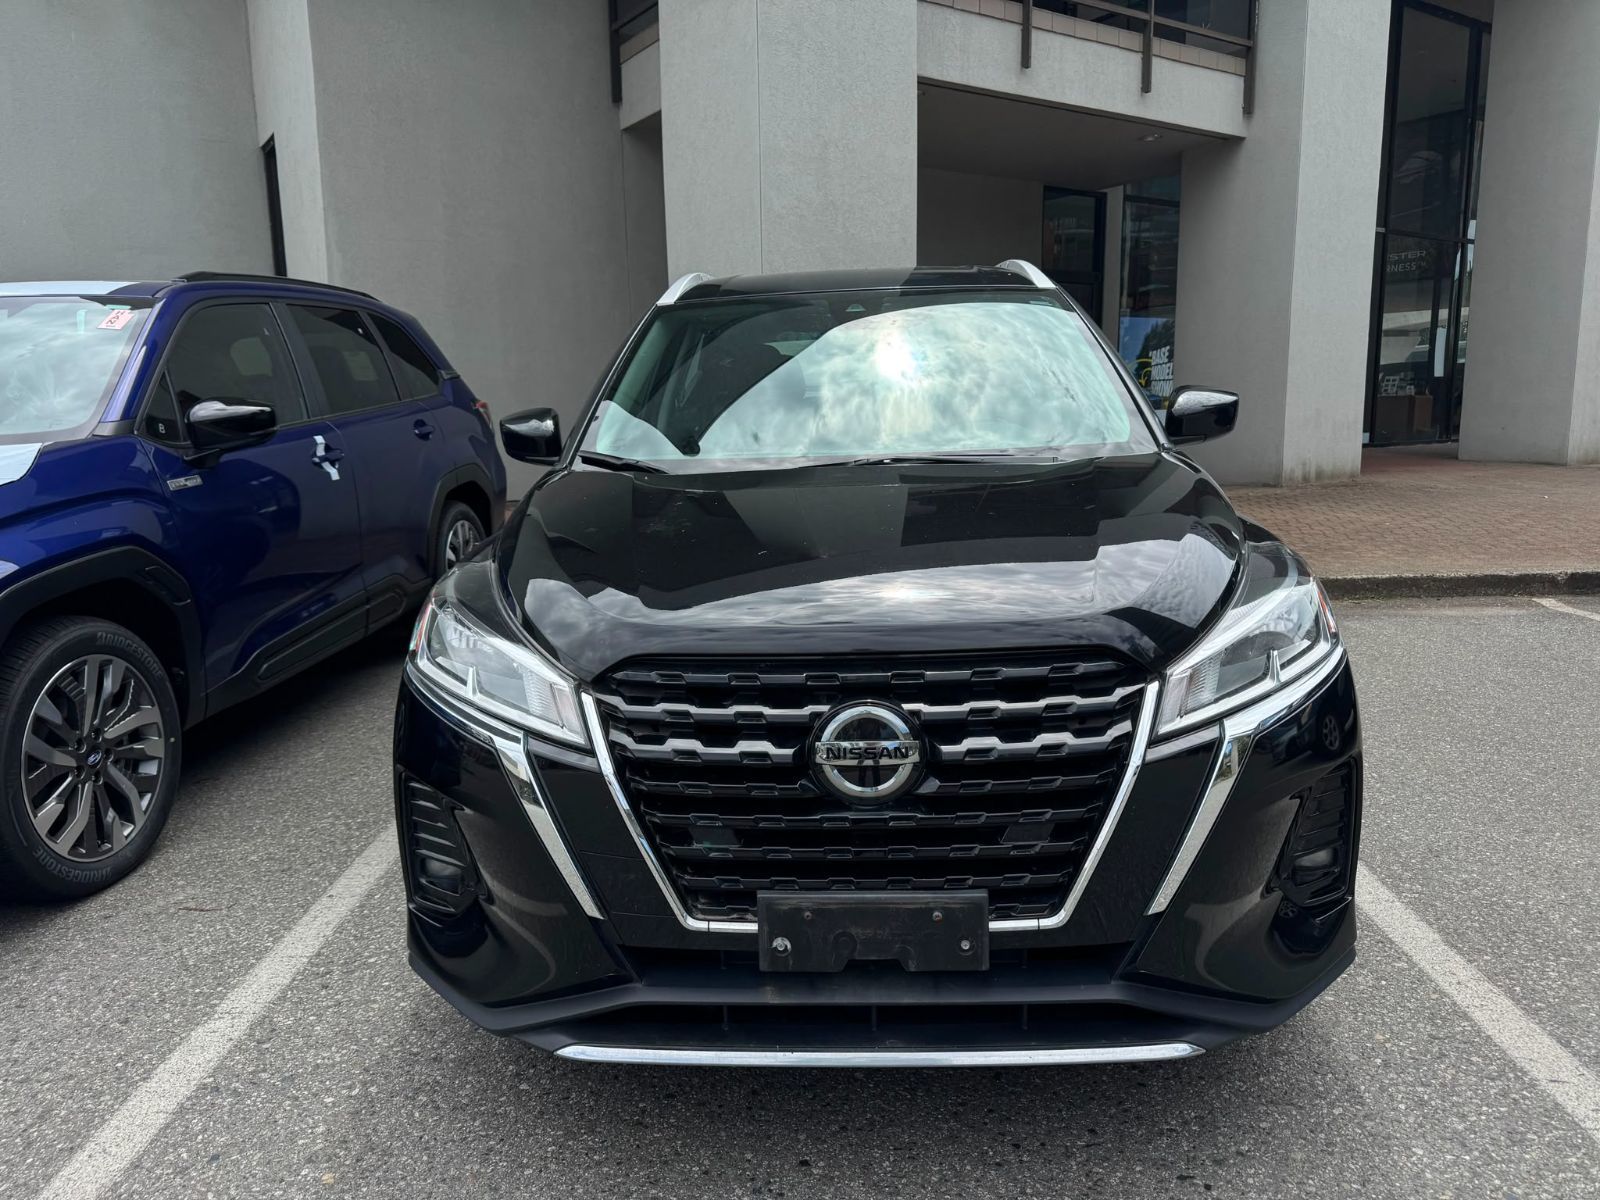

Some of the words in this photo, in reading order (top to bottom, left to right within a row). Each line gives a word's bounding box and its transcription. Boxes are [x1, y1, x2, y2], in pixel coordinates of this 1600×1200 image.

[96, 631, 164, 678] BRIDGESTONE
[826, 746, 909, 760] NISSAN
[32, 846, 112, 883] BRIDGESTONE
